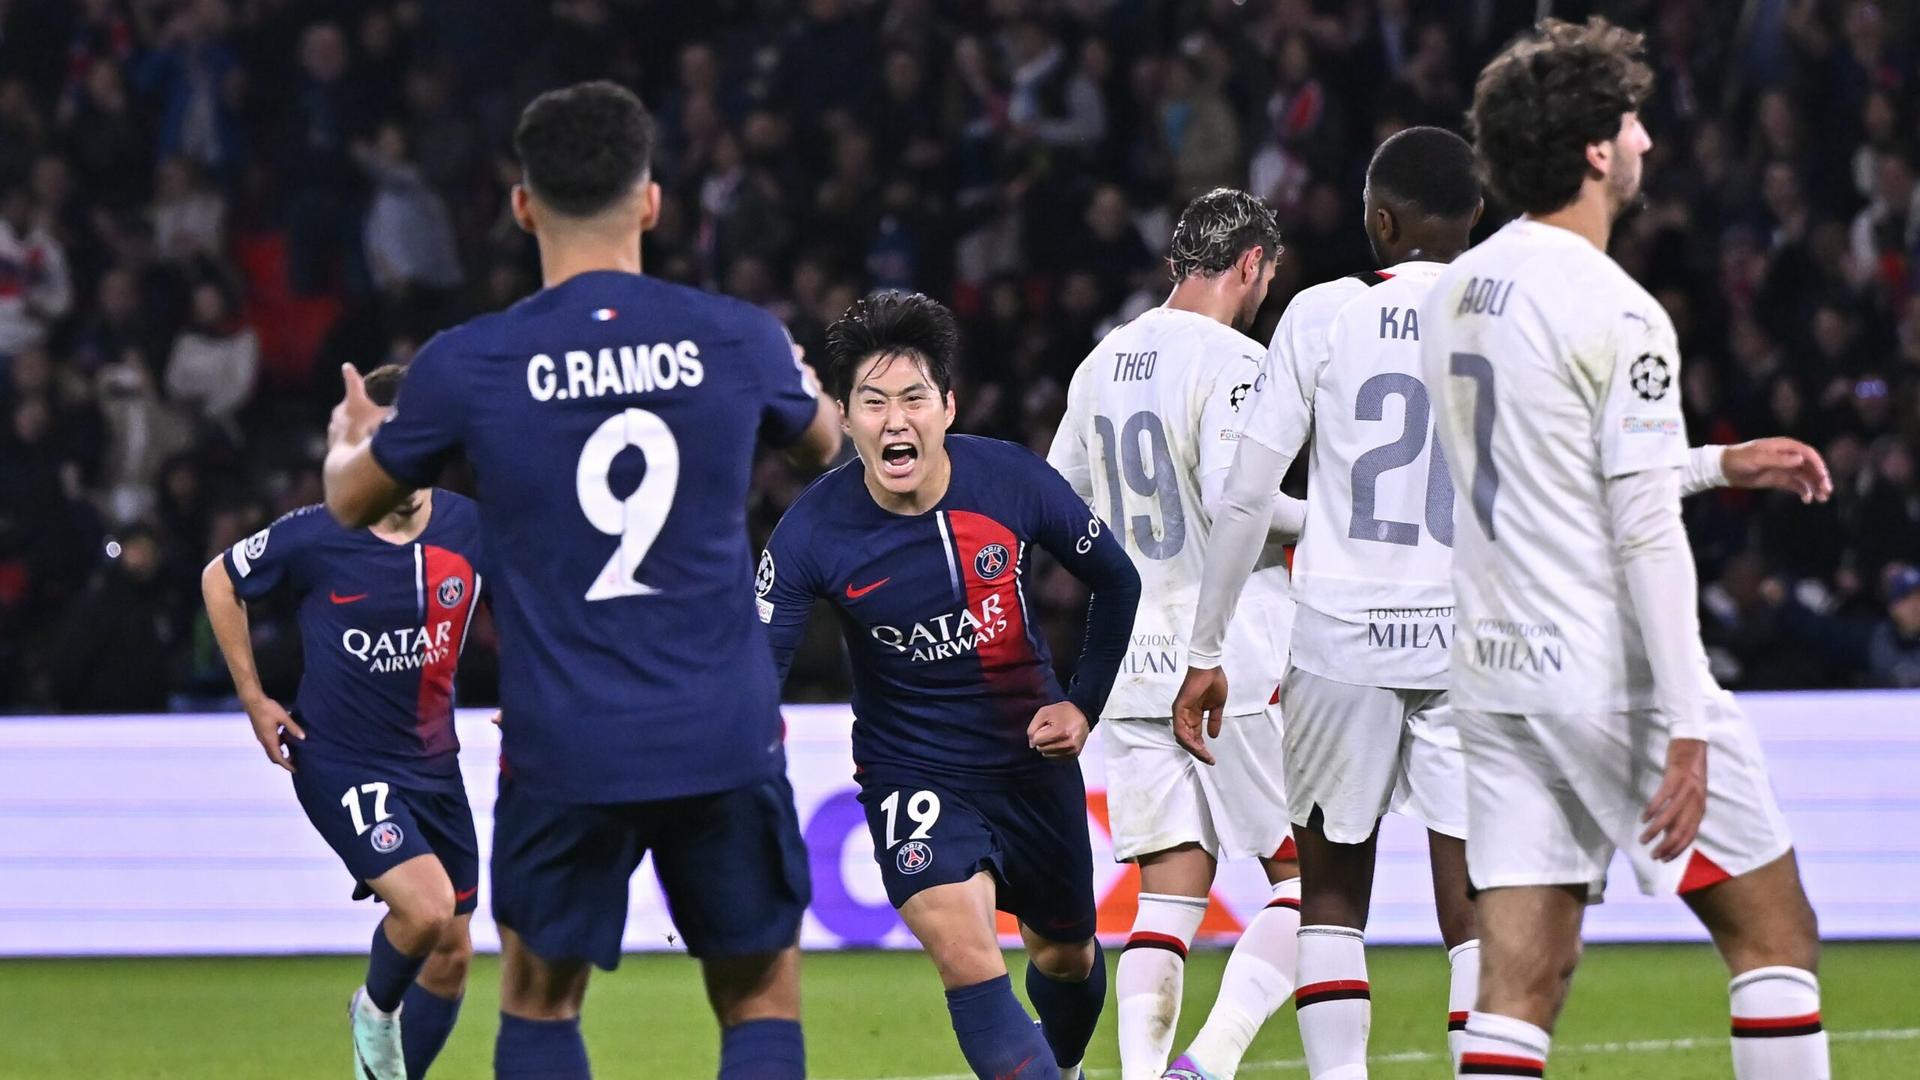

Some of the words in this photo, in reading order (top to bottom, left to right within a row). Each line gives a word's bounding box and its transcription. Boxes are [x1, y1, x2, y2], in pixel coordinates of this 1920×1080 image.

[1457, 276, 1514, 317] ADLI
[1380, 307, 1420, 341] KA
[527, 340, 705, 401] G.RAMOS
[1113, 351, 1157, 382] THEO
[1449, 352, 1499, 542] 7
[576, 408, 680, 601] 9
[1094, 411, 1186, 561] 19
[978, 545, 1003, 559] PARIS
[342, 620, 452, 662] QATAR
[871, 592, 1004, 652] QATAR
[911, 614, 1007, 662] AIRWAYS
[1368, 622, 1456, 649] MILA
[369, 646, 449, 673] AIRWAYS
[1474, 638, 1562, 673] MILAN
[341, 781, 396, 836] 17
[881, 789, 941, 850] 19
[899, 842, 923, 855] PARIS
